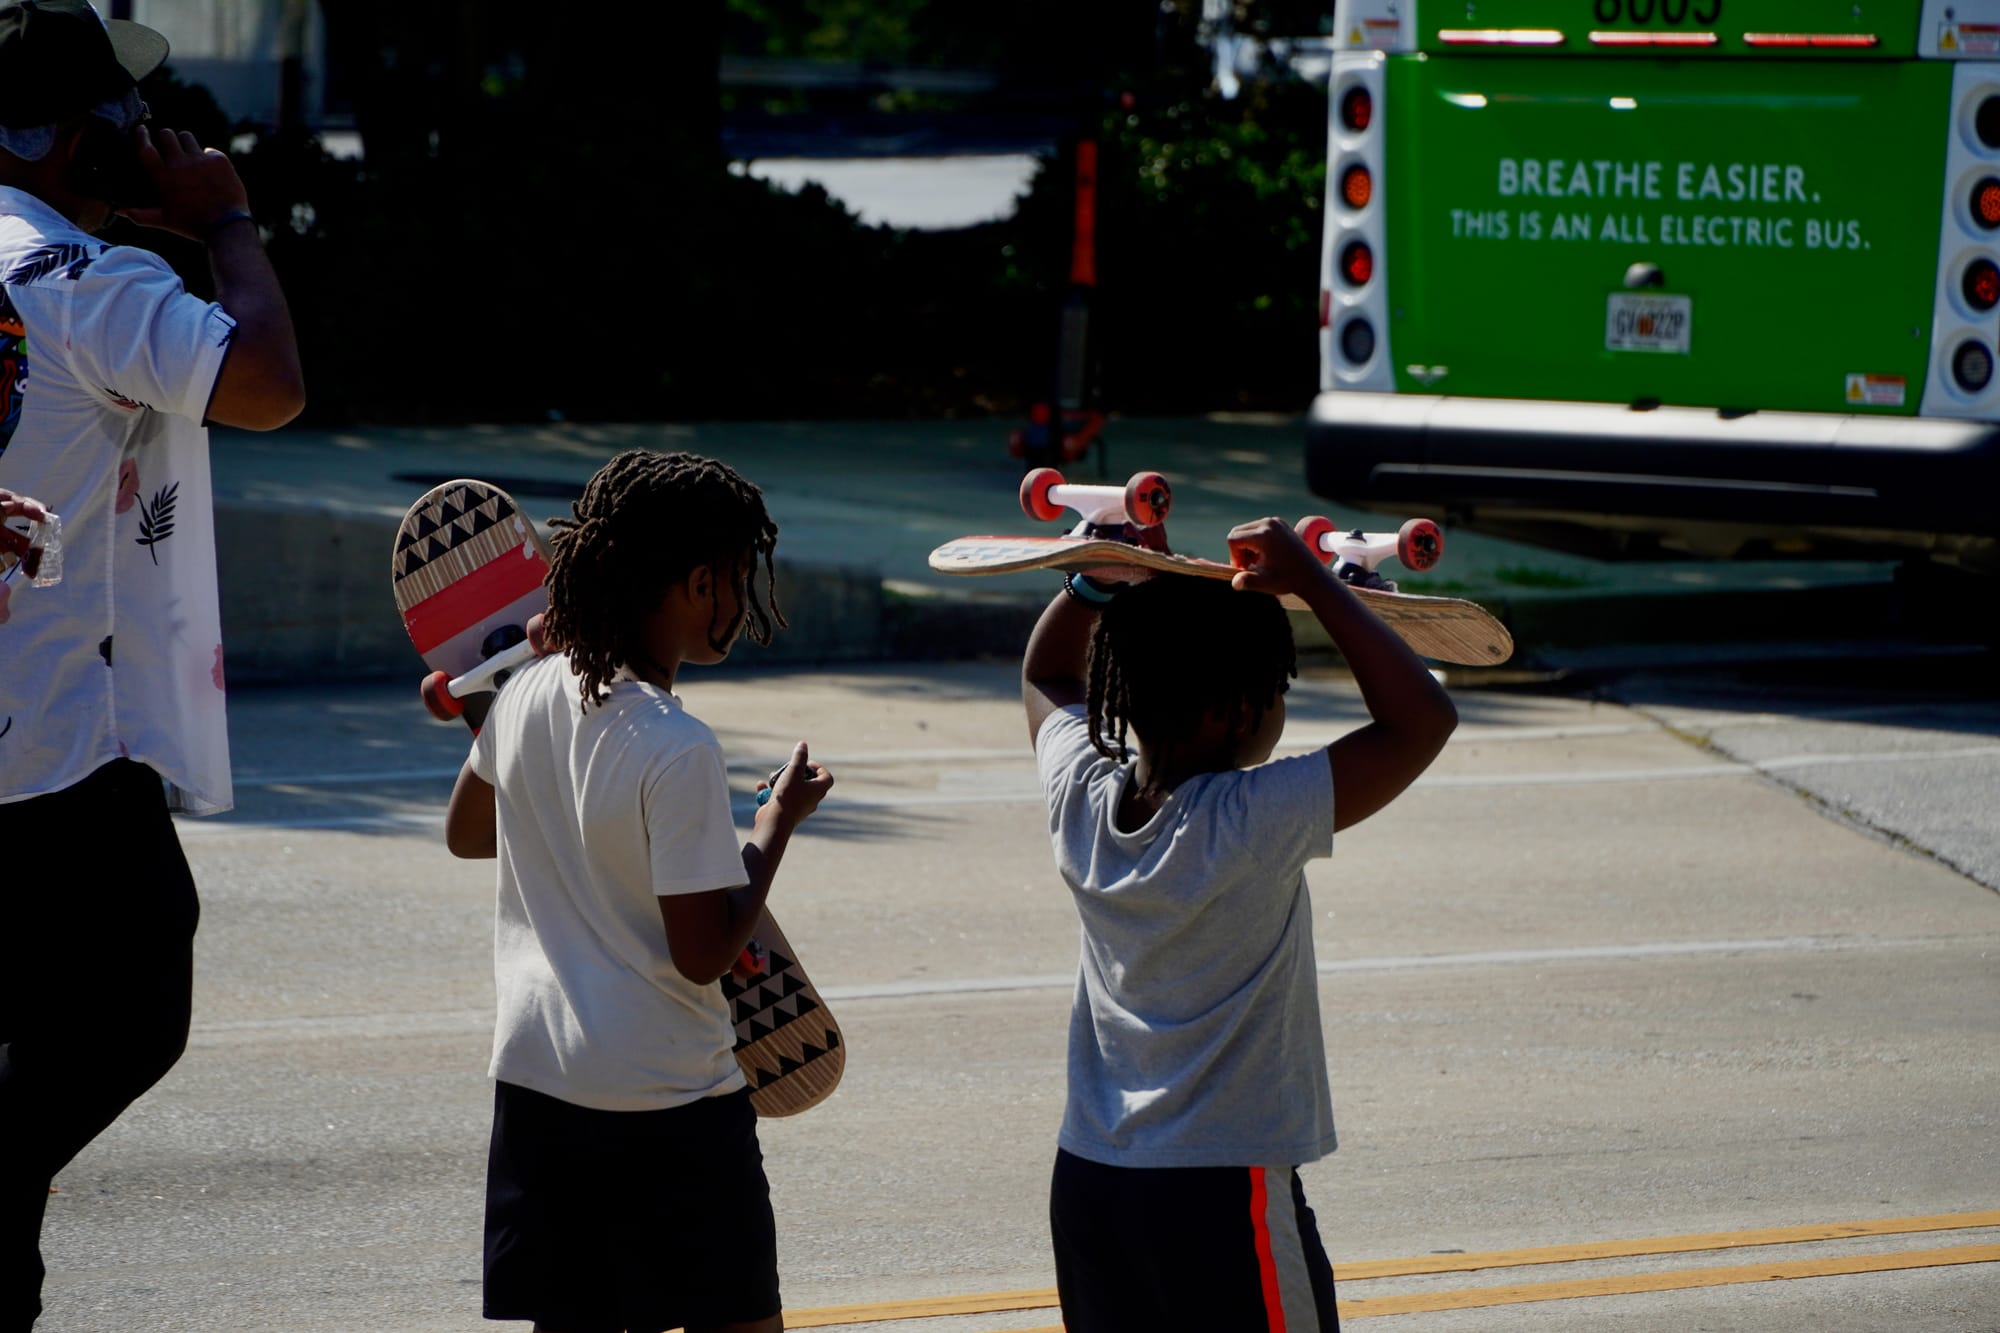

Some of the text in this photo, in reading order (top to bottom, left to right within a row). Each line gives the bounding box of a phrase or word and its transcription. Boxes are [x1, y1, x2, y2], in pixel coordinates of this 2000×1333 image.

[1498, 158, 1820, 203] BREATHE EASIER.
[1450, 208, 1870, 250] THIS IS AN ALL ELECTRIC BUS.
